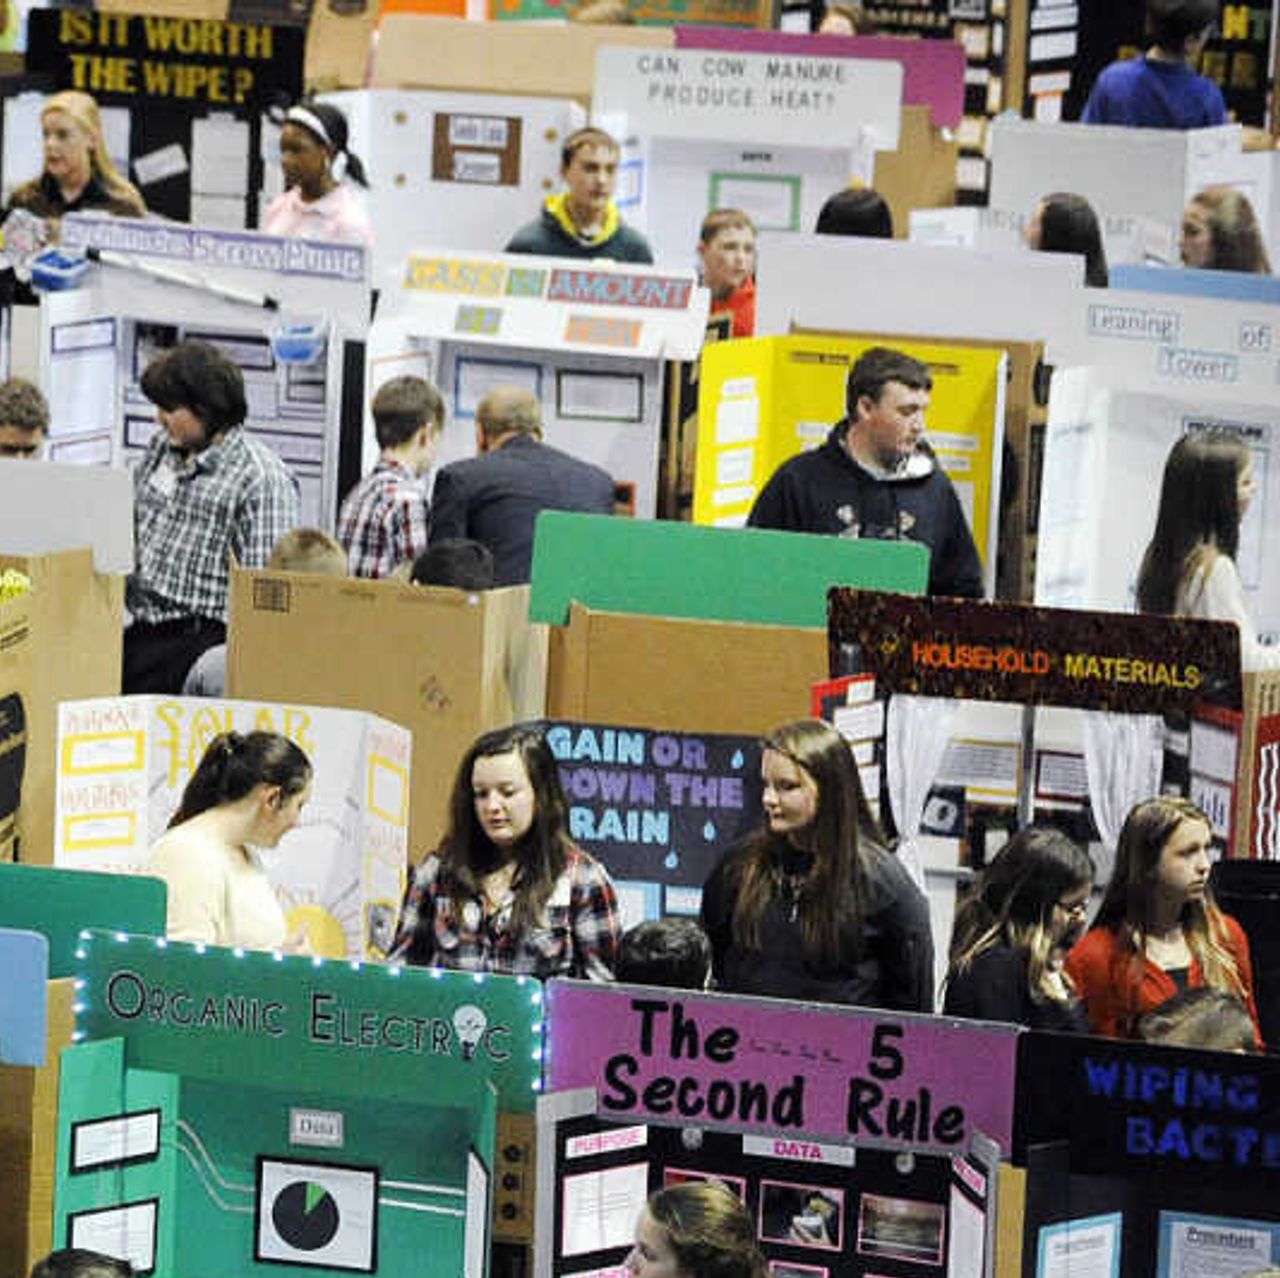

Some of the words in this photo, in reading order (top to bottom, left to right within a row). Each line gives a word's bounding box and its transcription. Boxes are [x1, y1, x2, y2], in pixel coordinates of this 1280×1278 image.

[144, 20, 272, 58] WORTH
[72, 54, 135, 90] THE
[638, 55, 678, 76] CAN
[705, 57, 746, 77] COW
[766, 60, 845, 83] MANURE
[648, 85, 753, 109] PRODUCE
[549, 269, 690, 308] AMOUNT
[1094, 306, 1173, 342] Leaning
[912, 642, 1050, 674] HOUSEHOLD
[1064, 654, 1203, 690] MATERIALS
[652, 736, 707, 769] OR
[665, 772, 743, 808] THE
[569, 806, 670, 846] RAIN
[633, 1000, 739, 1062] The
[869, 1024, 904, 1080] 5
[604, 1055, 805, 1128] Second
[846, 1078, 966, 1145] Rule
[1084, 1055, 1259, 1112] WIPING
[774, 1141, 822, 1161] DATA
